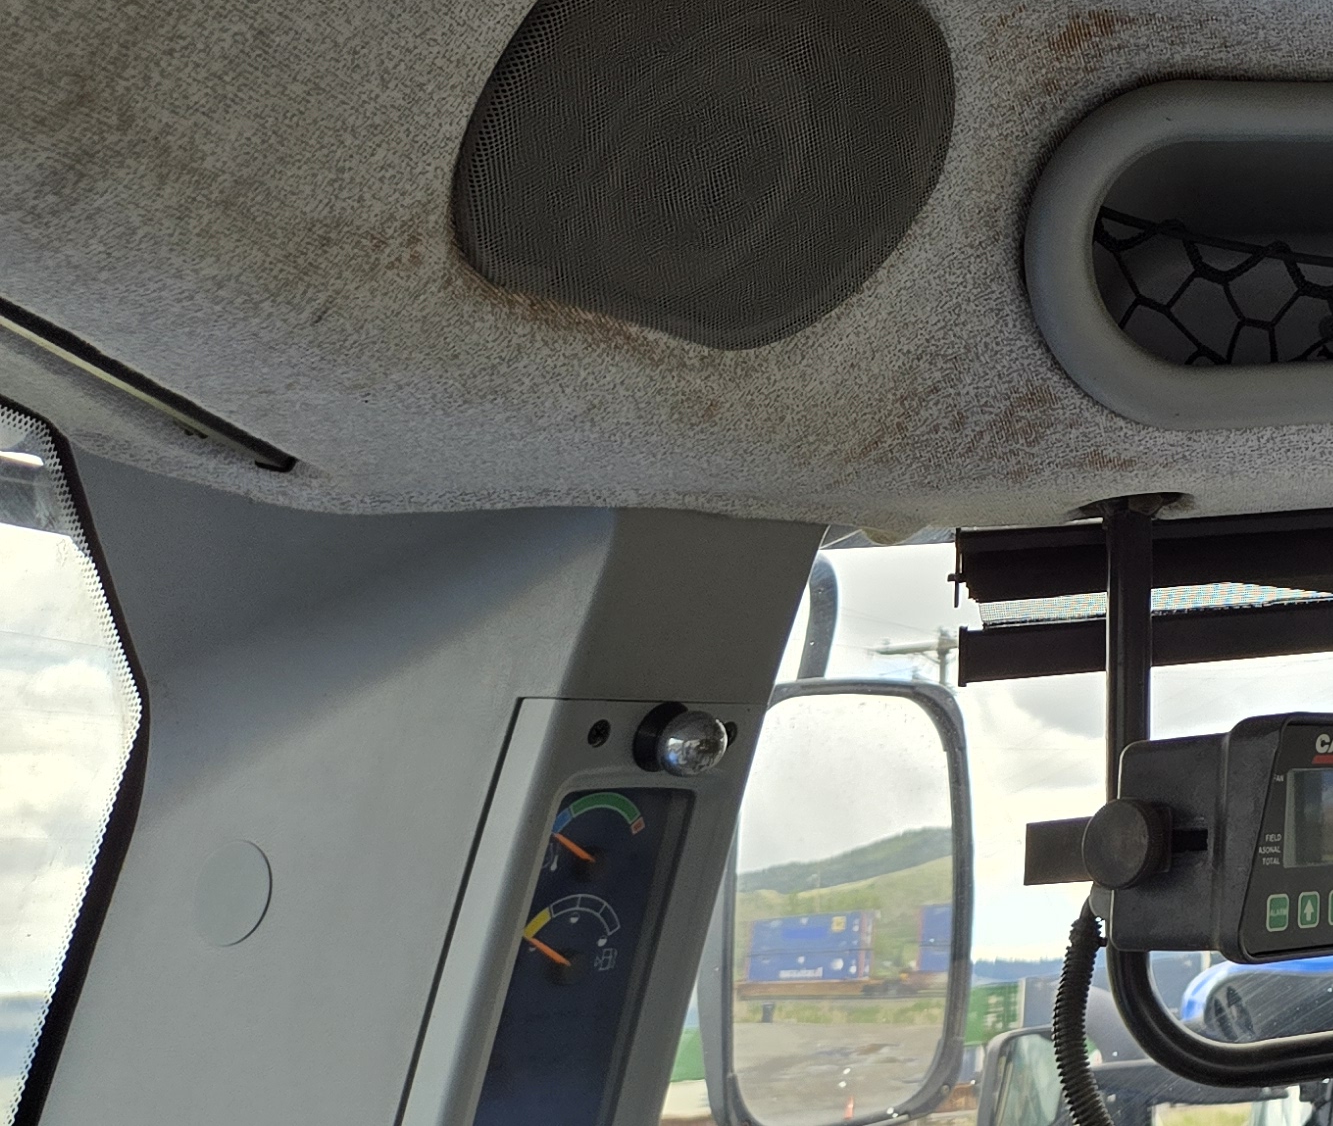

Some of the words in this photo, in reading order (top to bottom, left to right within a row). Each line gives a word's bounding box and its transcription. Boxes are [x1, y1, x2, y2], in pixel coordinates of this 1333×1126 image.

[1265, 834, 1282, 842] FIELD
[1258, 845, 1281, 854] ASONAL
[1262, 857, 1281, 865] TOTAL
